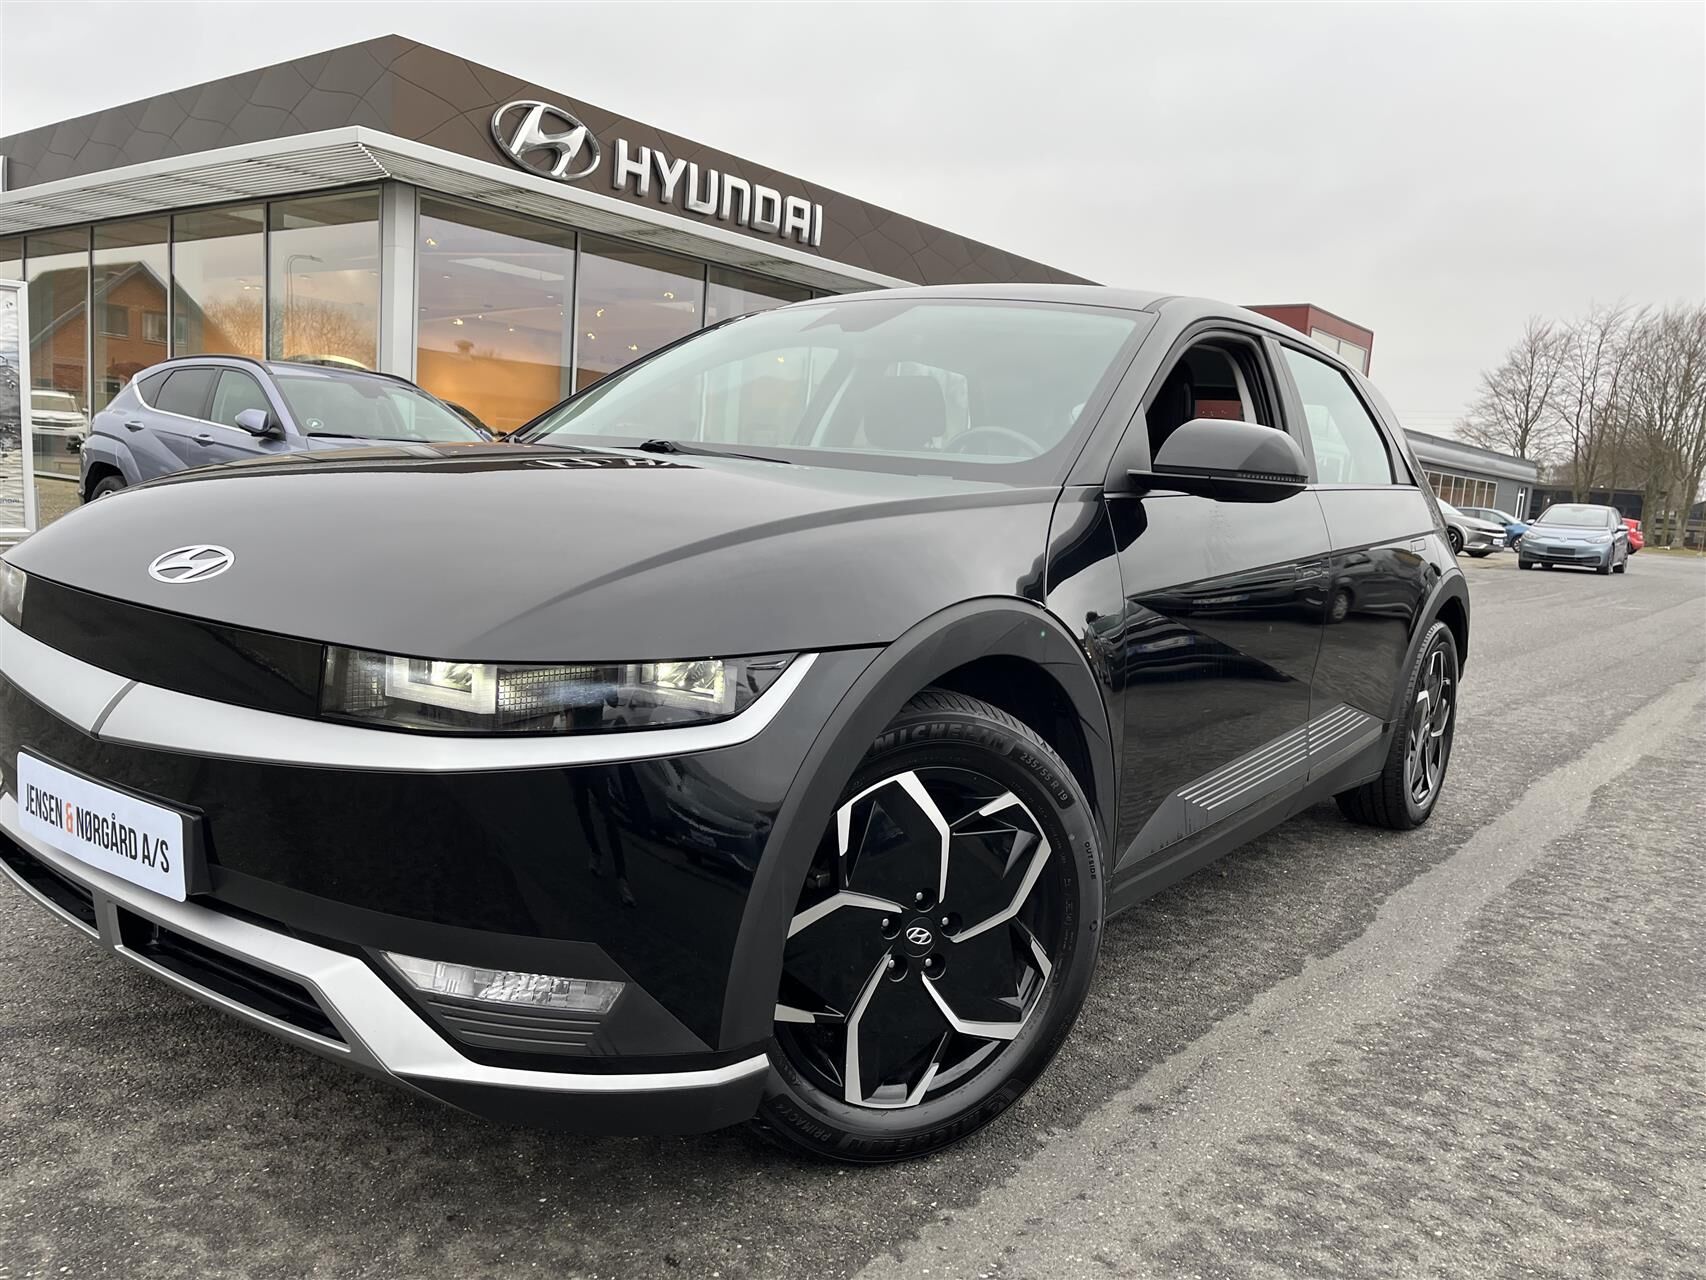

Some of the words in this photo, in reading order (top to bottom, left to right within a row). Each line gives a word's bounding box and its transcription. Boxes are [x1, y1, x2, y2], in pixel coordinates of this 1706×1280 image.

[613, 138, 823, 246] HYUNDAI
[1020, 752, 1054, 781] 235/55
[1050, 780, 1060, 789] R
[1057, 790, 1068, 801] 19
[25, 783, 63, 829] JENSEN
[65, 802, 74, 833] &
[76, 806, 138, 861] NØRGÅRD
[142, 833, 170, 873] A/S
[1084, 841, 1097, 880] OUTSIDE
[780, 1108, 833, 1142] PRIMACY
